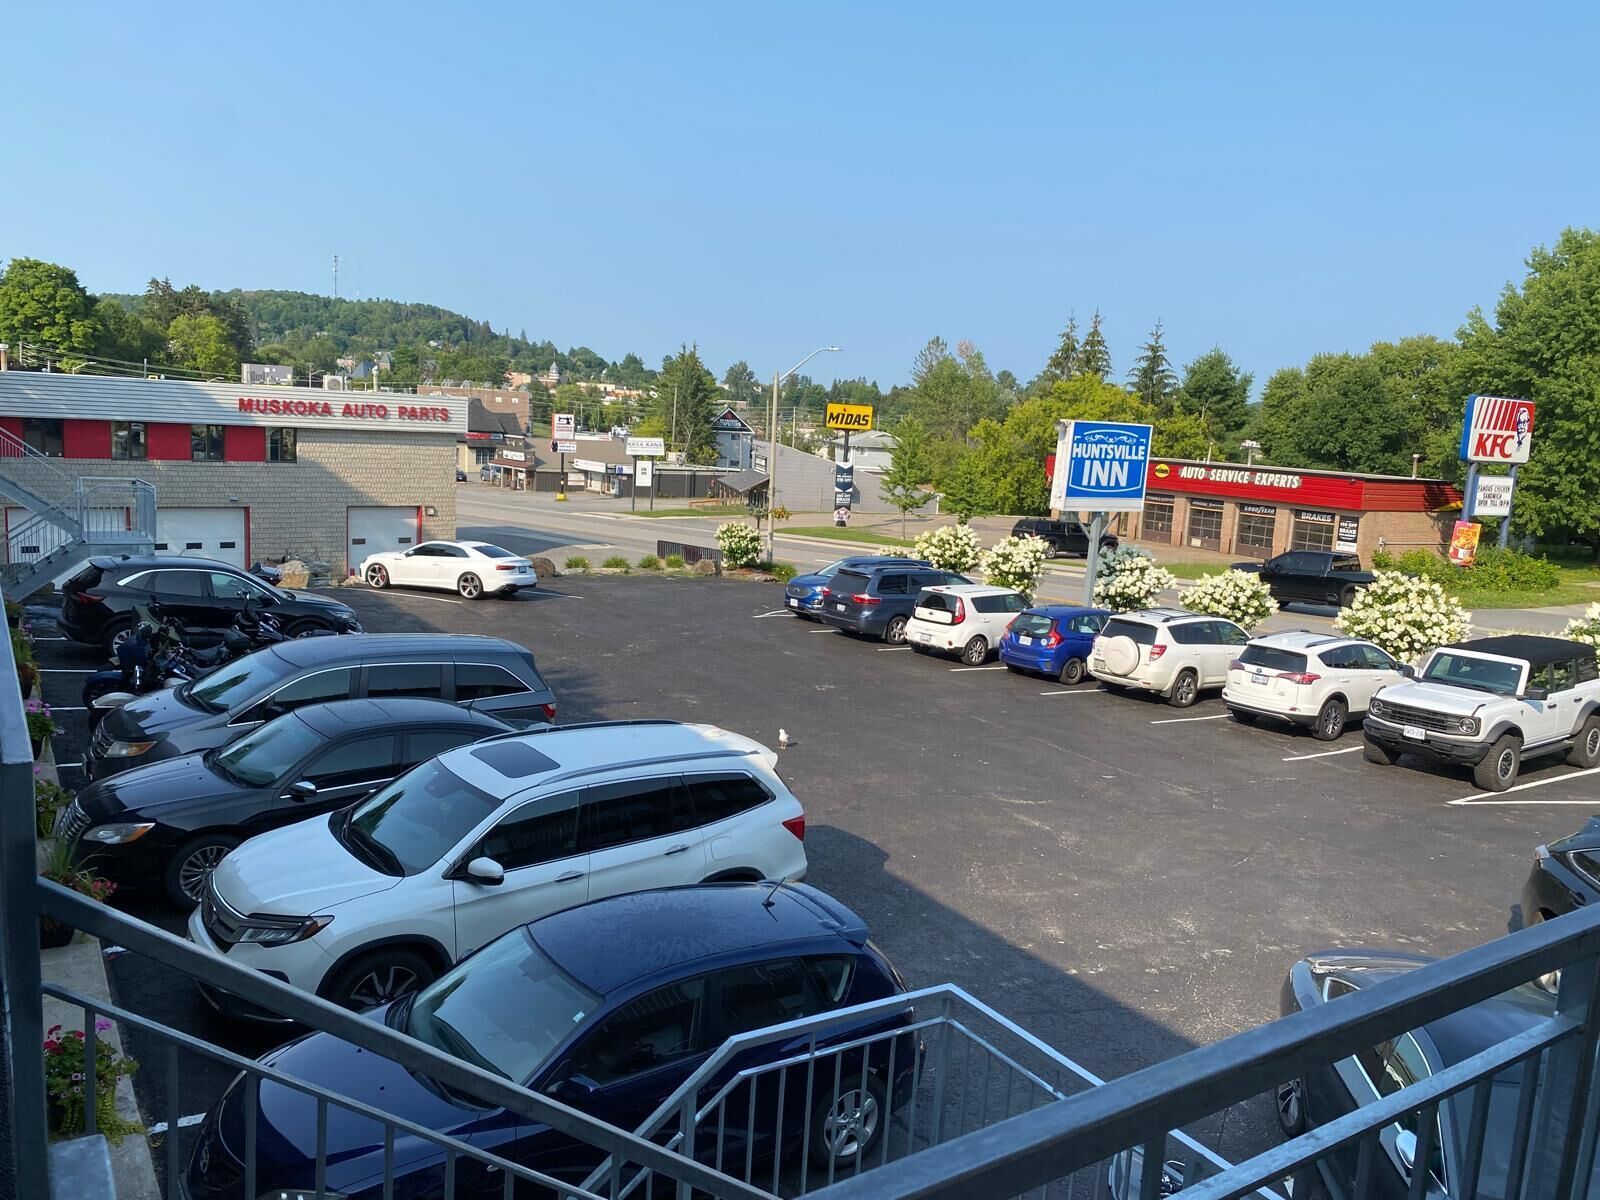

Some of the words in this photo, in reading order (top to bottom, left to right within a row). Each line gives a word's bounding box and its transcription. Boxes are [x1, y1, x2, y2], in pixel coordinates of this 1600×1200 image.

[238, 398, 332, 416] MUSKOKA
[342, 403, 388, 419] AUTO
[398, 406, 450, 422] PARTS
[828, 412, 869, 426] MIDAS
[1072, 443, 1145, 460] HUNTSVILLE
[1473, 433, 1515, 458] KFC
[1082, 460, 1128, 487] INN
[1180, 466, 1205, 480] AUTO
[1210, 468, 1250, 484] SERVICE
[1254, 472, 1300, 488] EXPERTS
[1244, 506, 1274, 514] GOODYEAR
[1301, 512, 1332, 522] BRAKES
